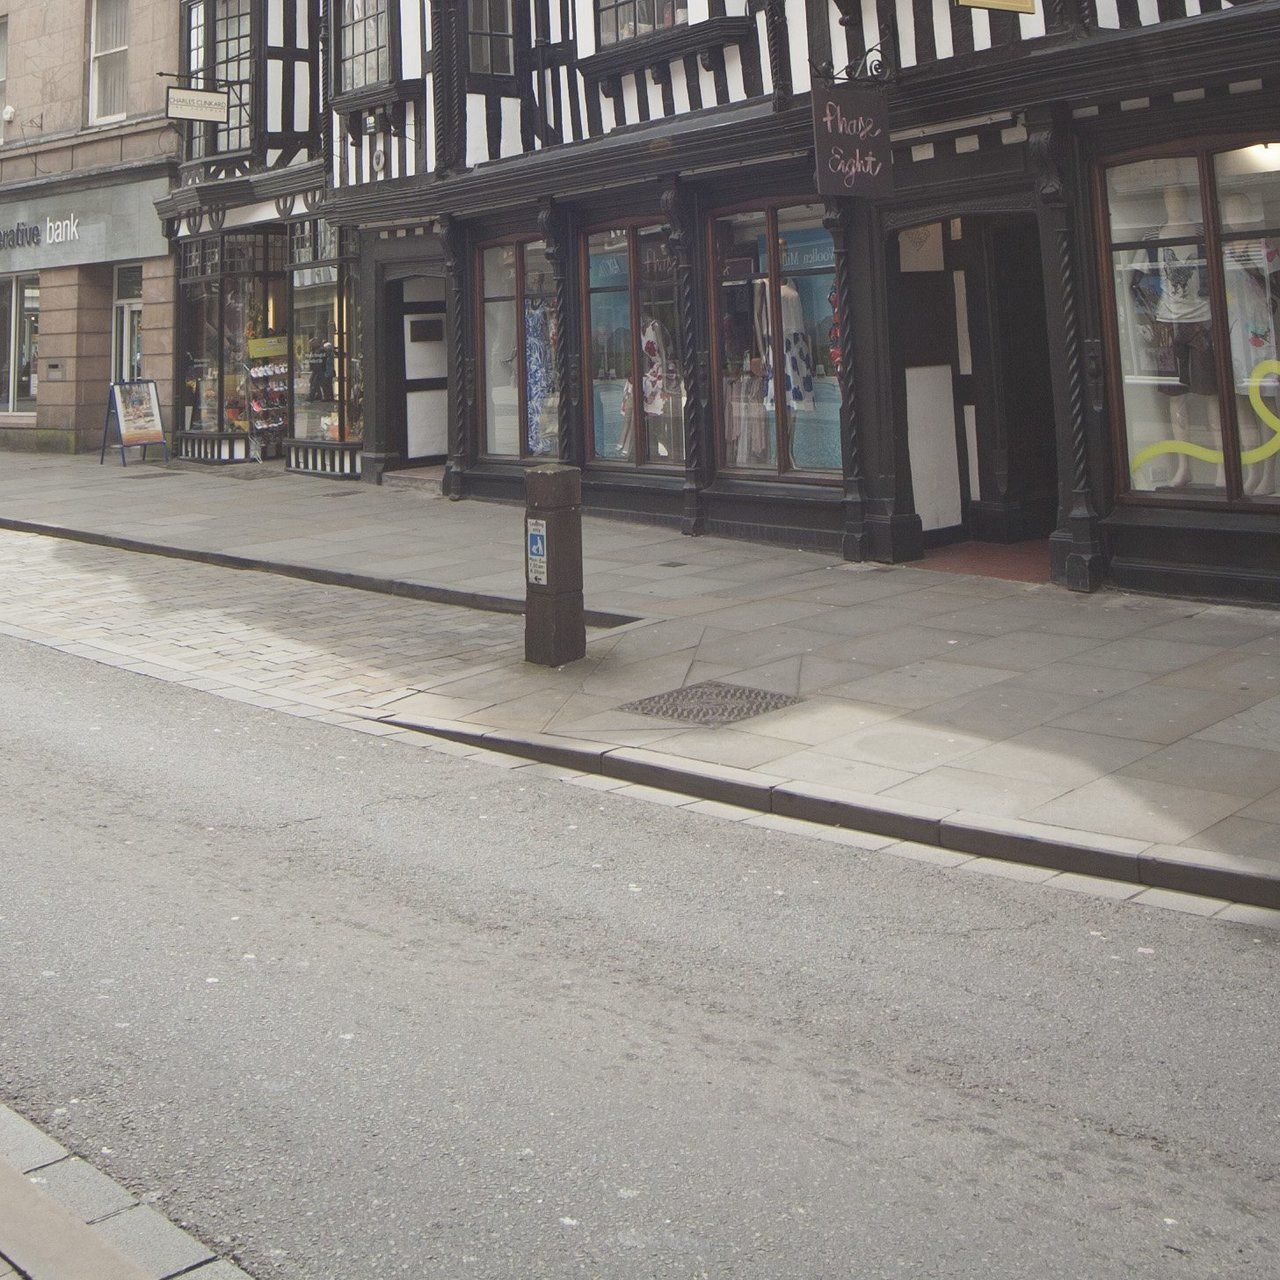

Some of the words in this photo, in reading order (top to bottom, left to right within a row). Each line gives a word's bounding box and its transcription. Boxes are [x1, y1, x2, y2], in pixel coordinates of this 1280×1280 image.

[822, 101, 882, 140] Phase
[828, 146, 882, 188] Eight
[46, 213, 80, 244] bank
